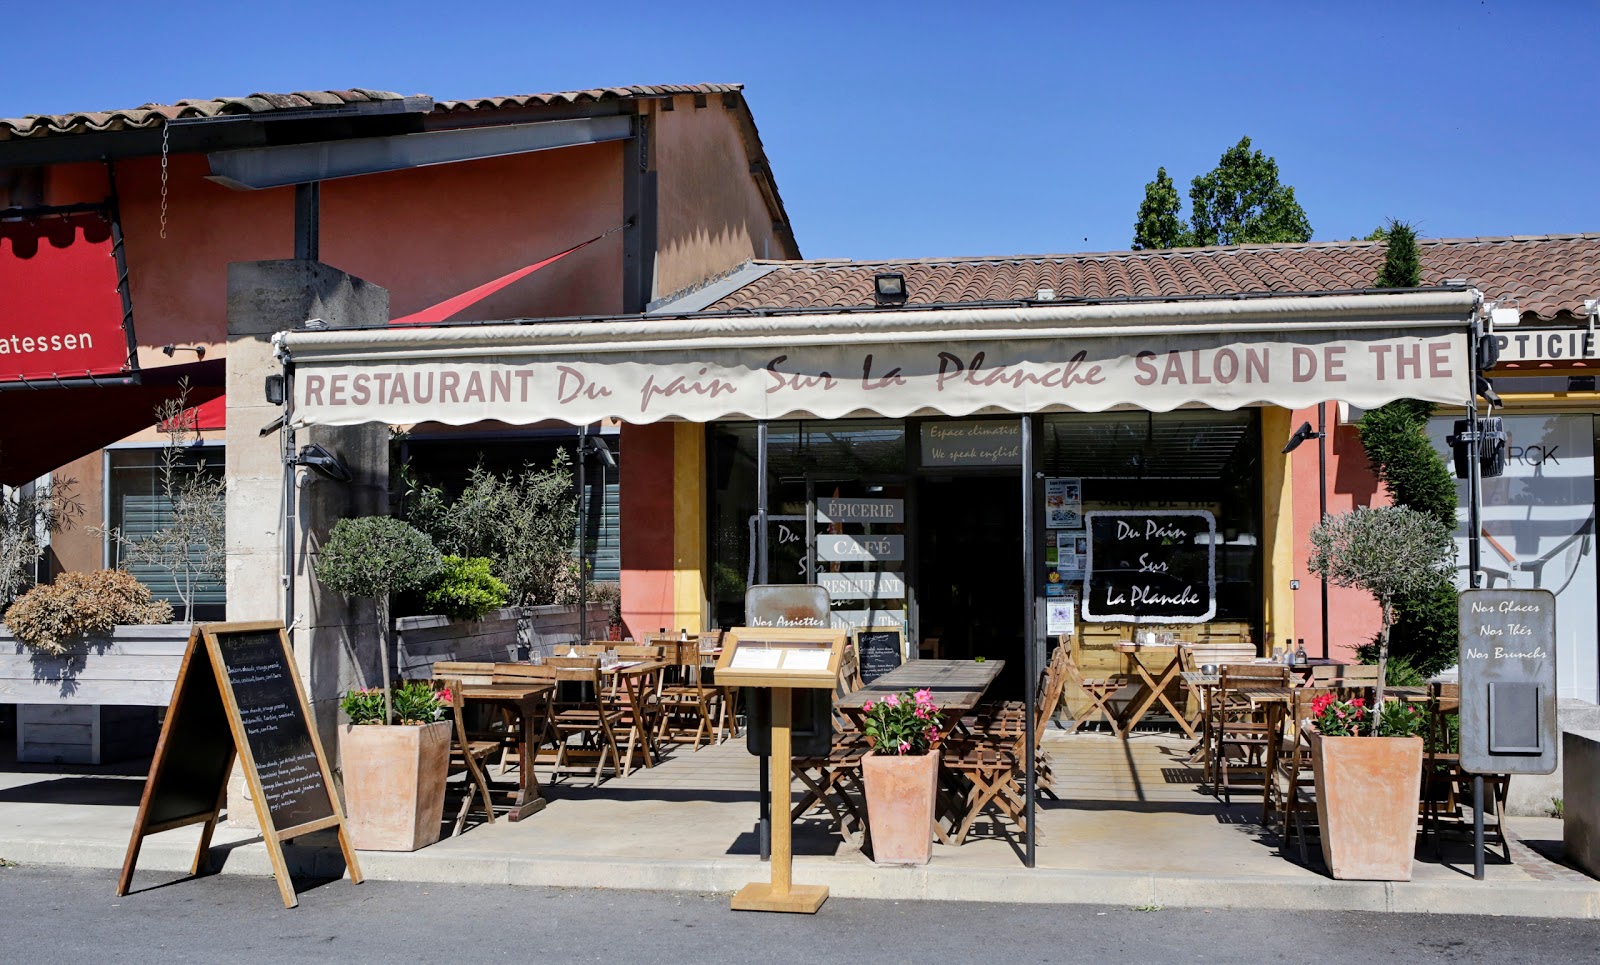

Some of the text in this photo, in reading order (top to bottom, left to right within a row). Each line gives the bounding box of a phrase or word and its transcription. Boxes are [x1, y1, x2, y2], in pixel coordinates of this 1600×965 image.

[0, 332, 93, 354] atessen
[1496, 332, 1596, 359] PTICIE
[305, 342, 1453, 412] RESTAURANT Du pain Sur La Planche SALON DE THE
[930, 424, 1020, 440] Espace climatisé
[932, 446, 1019, 462] We speak english
[1504, 445, 1560, 466] RCK
[828, 500, 894, 518] ÉPICERIE
[778, 524, 801, 544] Du
[1116, 519, 1187, 540] Du Pain
[833, 536, 891, 555] CAFÉ
[1138, 552, 1169, 573] Sur
[822, 580, 900, 593] RESTAURANT
[1106, 584, 1200, 607] La Planche
[1471, 601, 1540, 614] Nos Glaces
[752, 615, 824, 628] Nos Assiettes
[830, 618, 856, 630] alon
[1480, 624, 1533, 636] Nos Thés
[1466, 646, 1548, 660] Nos Brunchs
